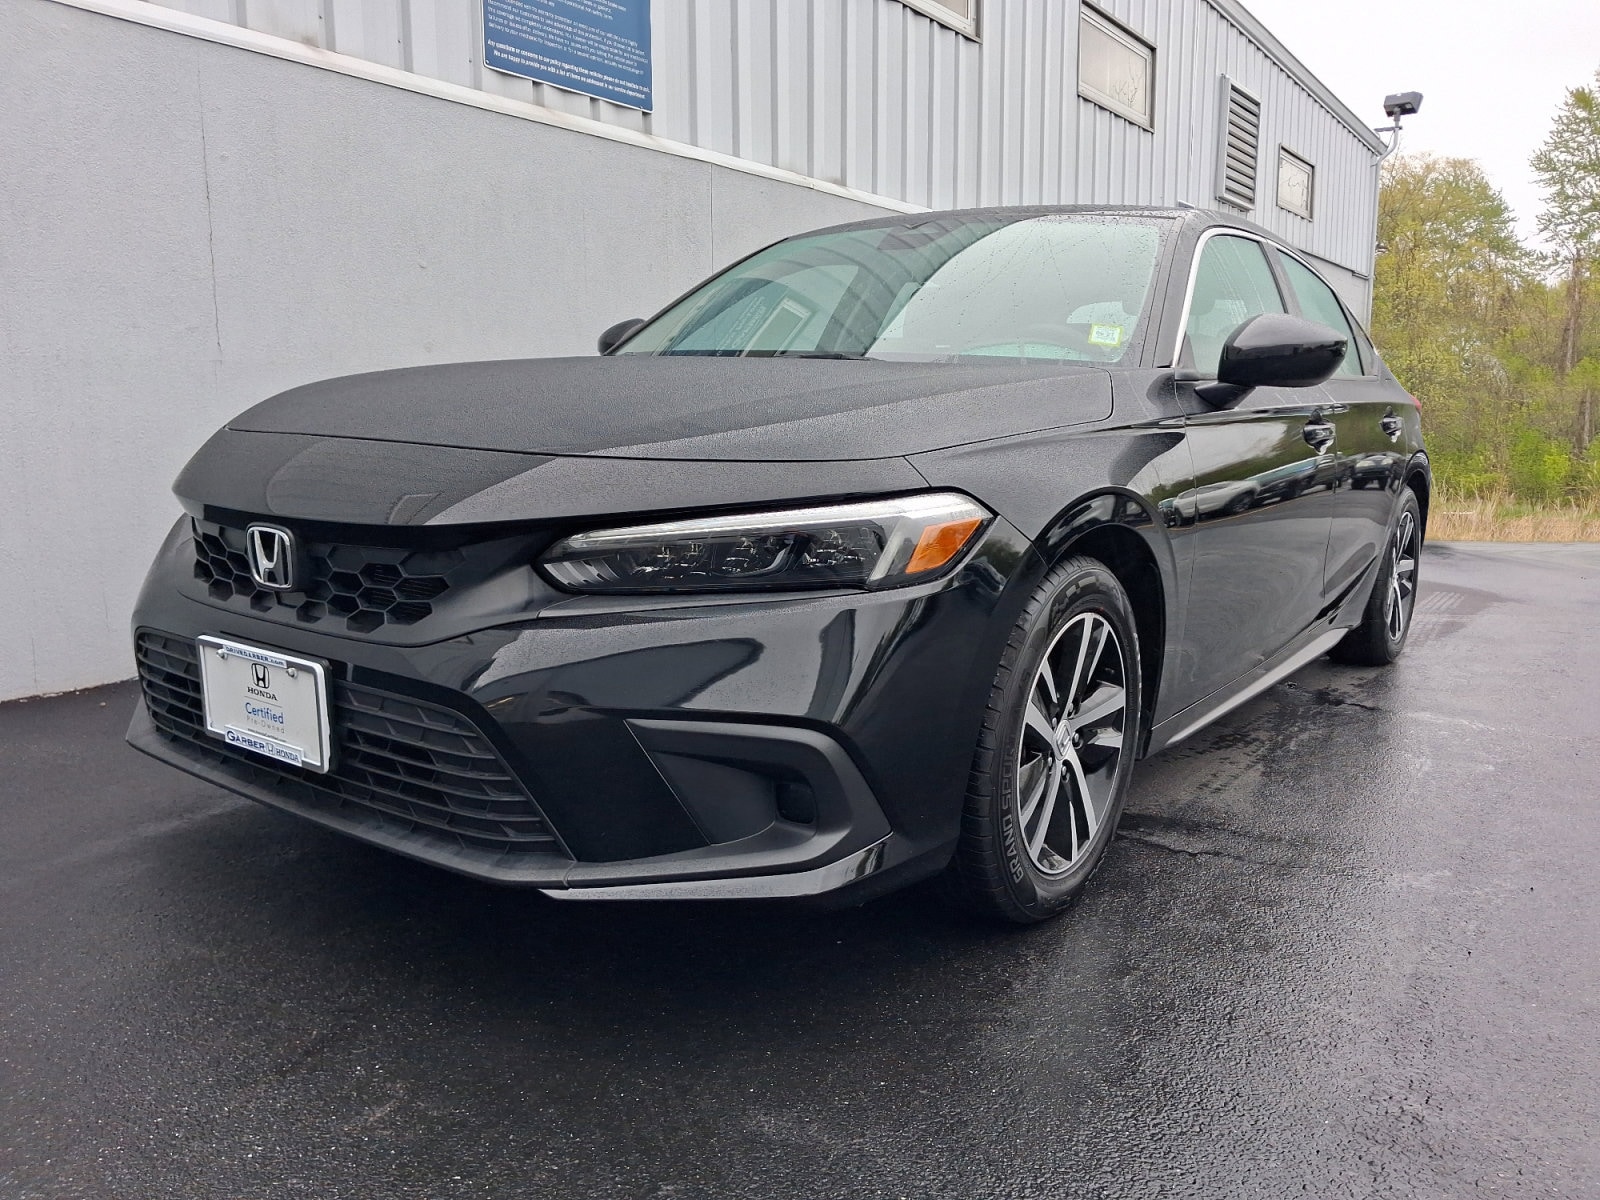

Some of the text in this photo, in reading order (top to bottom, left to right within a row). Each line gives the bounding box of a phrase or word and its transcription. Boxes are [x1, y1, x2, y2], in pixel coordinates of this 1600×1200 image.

[247, 686, 278, 701] HONDA
[245, 702, 284, 724] Certified
[226, 730, 265, 750] GARBER
[275, 747, 300, 762] HONDA
[1002, 814, 1024, 884] GRAND
